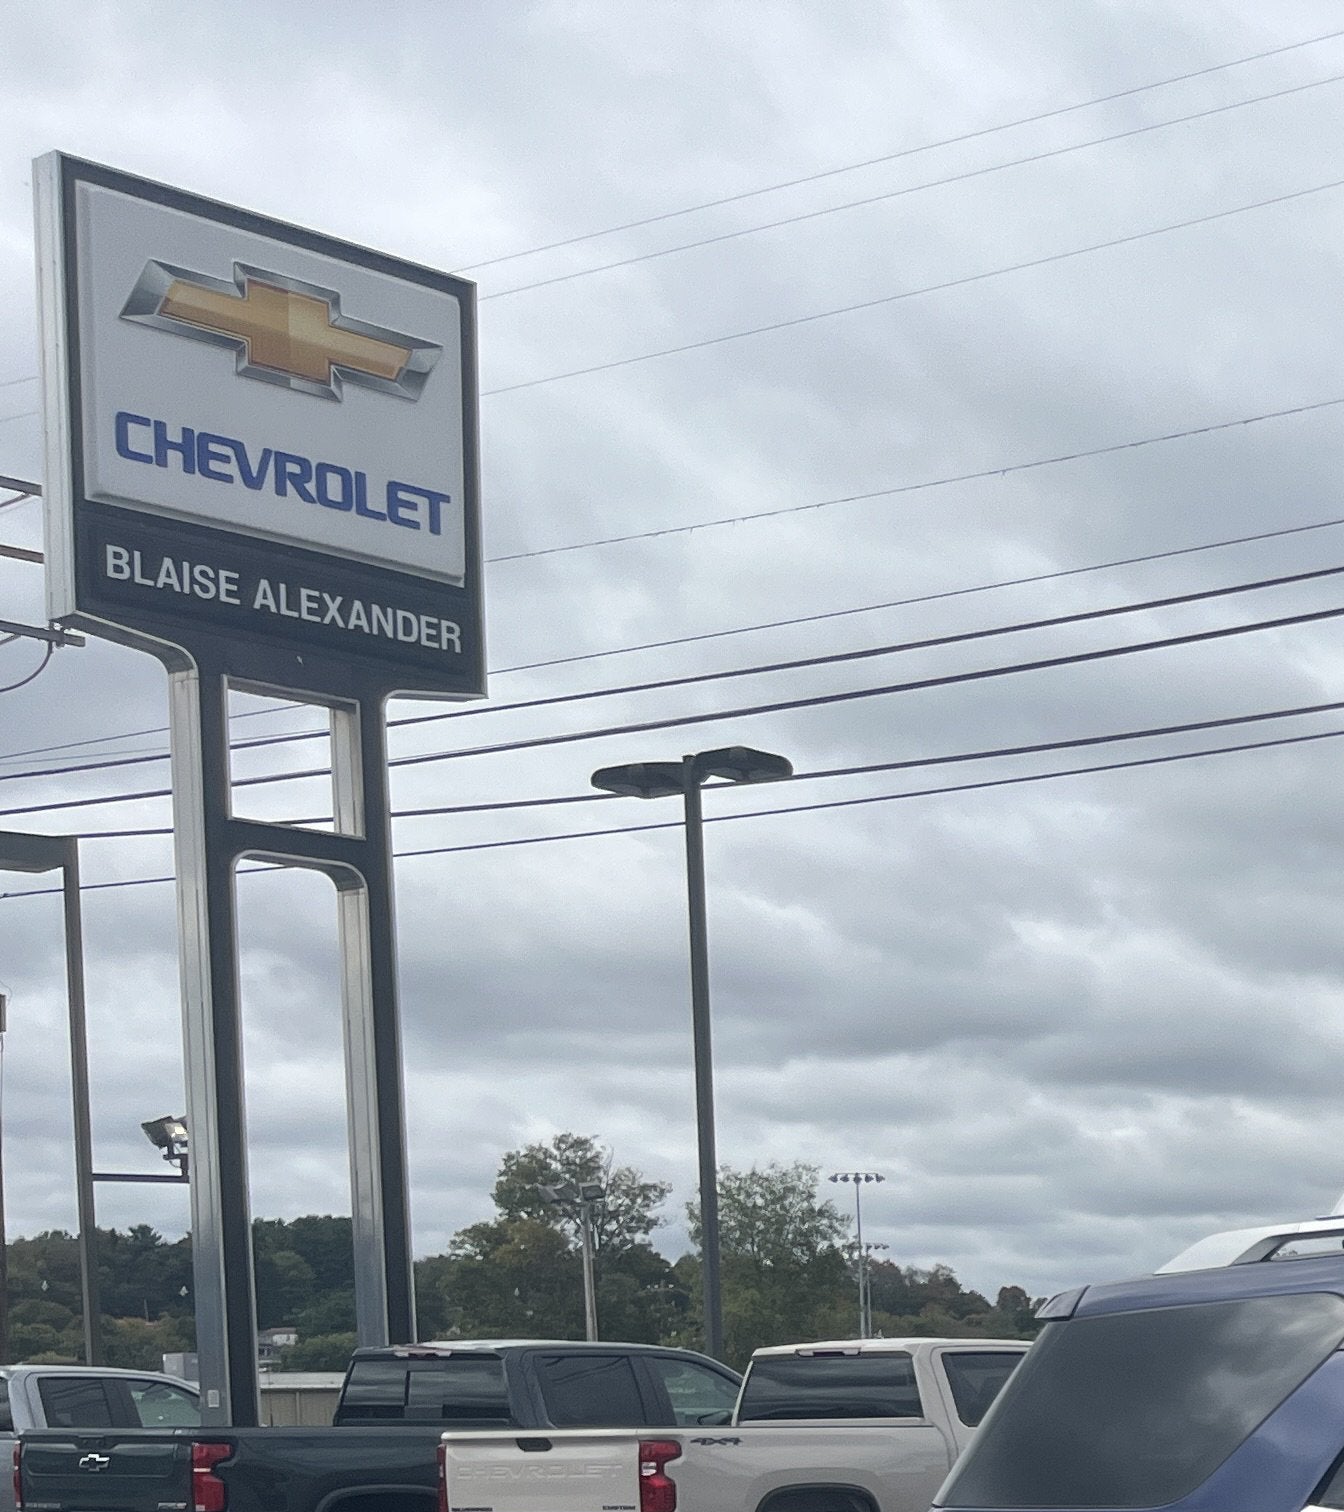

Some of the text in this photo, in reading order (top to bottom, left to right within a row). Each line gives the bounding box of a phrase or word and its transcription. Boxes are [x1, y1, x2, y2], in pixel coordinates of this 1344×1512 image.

[115, 411, 451, 535] CHEVROLET
[106, 543, 462, 654] BLAISE ALEXANDER
